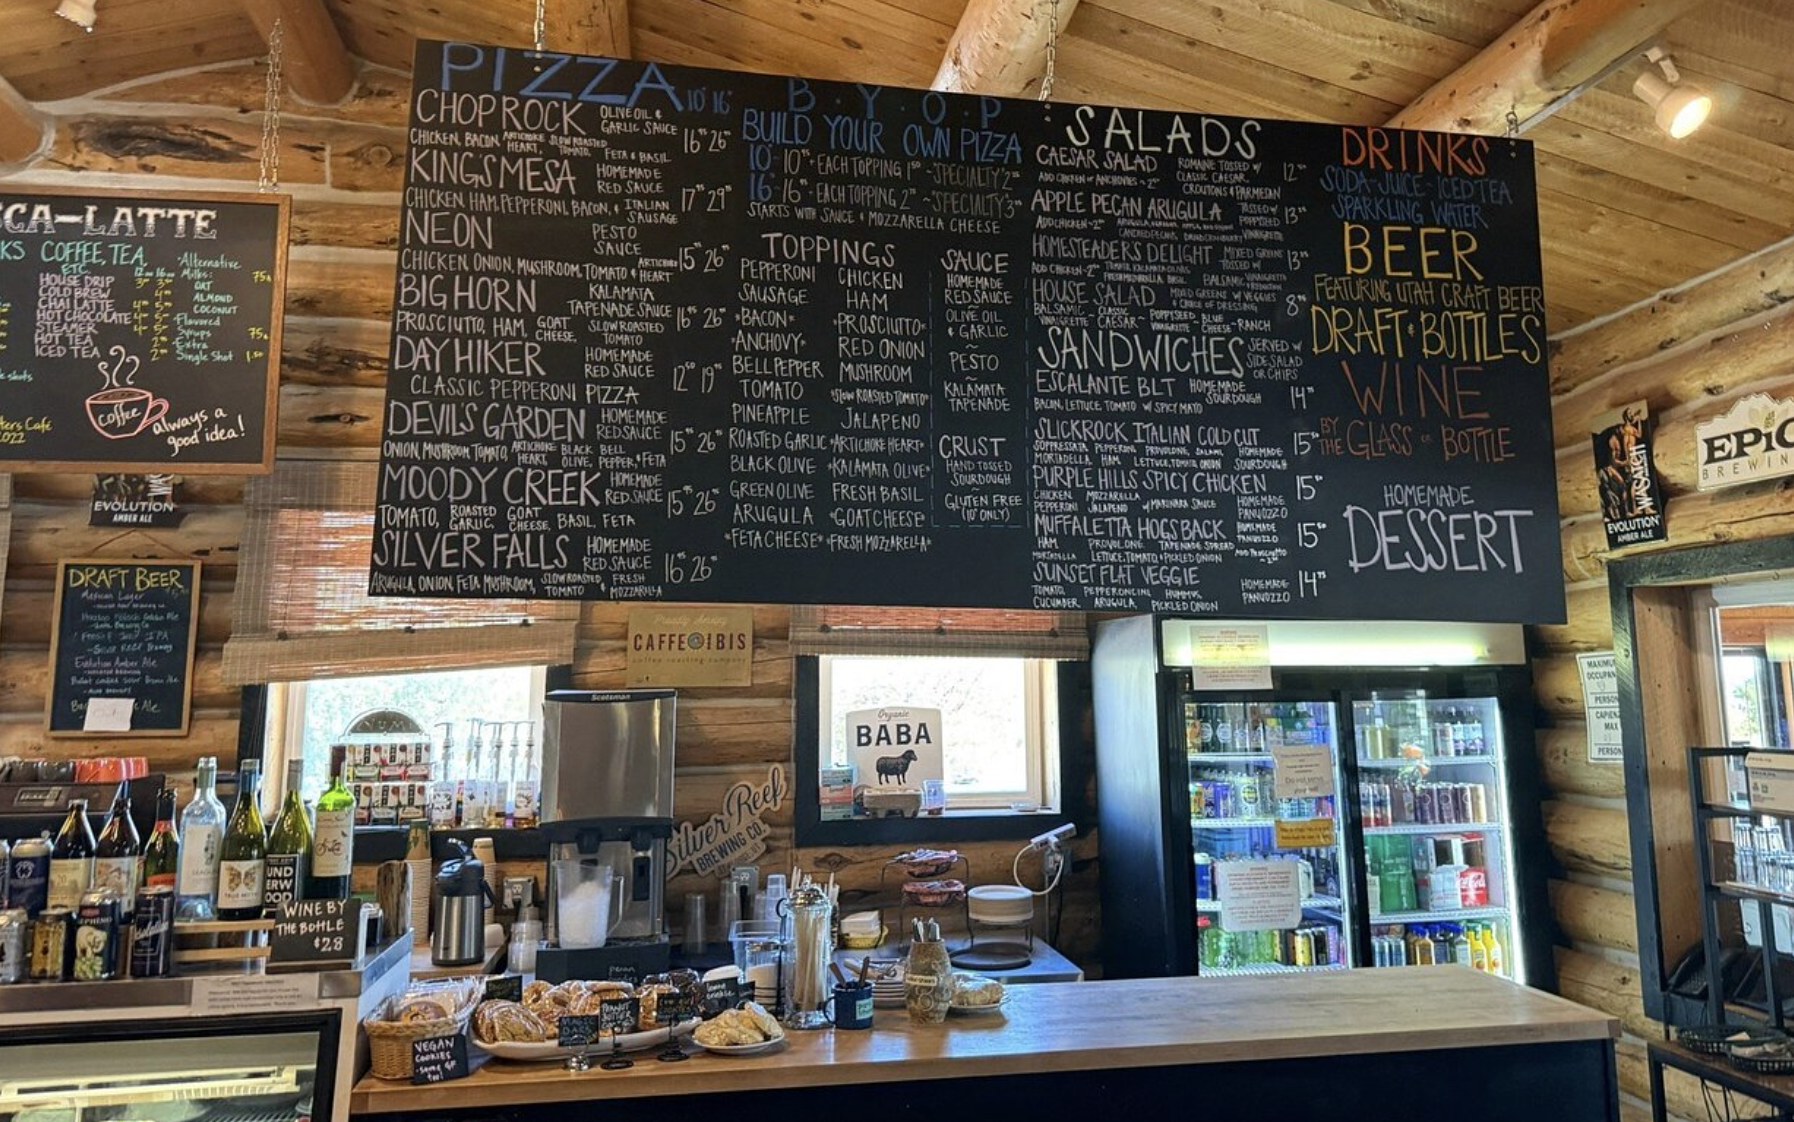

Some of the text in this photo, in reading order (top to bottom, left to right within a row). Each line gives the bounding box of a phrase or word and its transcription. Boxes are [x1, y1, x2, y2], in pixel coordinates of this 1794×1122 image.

[442, 43, 684, 111] PIZZA
[601, 120, 677, 136] GARLIC SAUCE
[742, 108, 1023, 164] BUILD YOUR OWN PIZZA
[1065, 105, 1262, 160] SALADS
[1035, 145, 1158, 173] CAESAR SALAD
[1342, 126, 1489, 176] DRINKS
[499, 156, 576, 195] MESA
[596, 163, 662, 179] HOMEMADE
[817, 154, 901, 179] EACH TOPPING
[1476, 178, 1513, 205] TEA
[624, 200, 669, 212] ITALIAN
[1031, 189, 1223, 222] APPLE PECAN ARUGULA
[1331, 192, 1490, 230] SPARKLING WATER
[406, 210, 493, 249] NEON
[627, 212, 678, 225] SAUSAGE
[592, 224, 637, 240] PESTO
[761, 232, 896, 268] TOPPINGS
[941, 249, 1010, 274] SAUCE
[1149, 243, 1214, 265] DELIGHT
[1343, 221, 1485, 282] BEER
[39, 272, 115, 288] HOUSE DRIP
[740, 259, 816, 282] PEPPERONI
[837, 267, 904, 290] CHICKEN
[38, 285, 110, 300] COLD BREW
[193, 292, 233, 304] ALMOND
[589, 283, 654, 300] KALAMATA
[738, 282, 809, 306] SAUSAGE
[846, 289, 888, 312] HAM
[1032, 279, 1155, 307] HOUSE SALAD
[1314, 273, 1392, 303] FEATURING
[1396, 280, 1435, 305] UTAH
[1440, 282, 1492, 311] CRAFT
[1498, 285, 1546, 313] BEER
[36, 308, 133, 325] HOT CHOCOLATE
[37, 297, 114, 313] CHAI LATTE
[192, 305, 239, 316] COCONUT
[568, 299, 672, 318] TAPENADE SAUCE
[35, 321, 98, 336] STEAMER
[1238, 319, 1271, 332] RANCH
[1310, 304, 1541, 365] DRAFT BOTTLES
[34, 345, 100, 359] ICED TEA
[838, 336, 925, 361] RED ONION
[1038, 325, 1245, 379] SANDWICHES
[584, 363, 655, 378] RED SAUCE
[839, 361, 913, 384] MUSHROOM
[949, 351, 999, 373] PESTO
[410, 374, 639, 405] CLASSIC PEPPERONI PIZZA
[739, 379, 804, 400] TOMATO
[1036, 369, 1176, 398] ESCALANTE BLT
[1340, 360, 1491, 420] WINE
[98, 401, 143, 429] coffee
[151, 407, 228, 436] always a
[482, 405, 586, 443] GARDEN
[601, 409, 667, 424] HOMEMADE
[732, 403, 811, 426] PINEAPPLE
[840, 407, 921, 430] JALAPENO
[167, 414, 246, 457] good idea!
[1034, 416, 1260, 447] SLICKROCK ITALIAN COLD CUT
[1318, 416, 1516, 463] BY THE GLASS BOTTLE
[938, 434, 1007, 459] CRUST
[382, 465, 601, 507] MOODY CREEK
[1033, 465, 1267, 495] PURPLE HILLS SPICY CHICKEN
[94, 501, 175, 513] EVOLUTION
[944, 493, 1023, 509] GLUTEN FREE
[1383, 484, 1475, 508] HOMEMADE
[112, 512, 153, 524] AMBER ALE
[732, 503, 815, 525] ARUGULA
[1034, 514, 1132, 537] MUFFALETTA
[1607, 515, 1660, 535] EVOLUTION
[1342, 503, 1535, 576] DESSERT
[1617, 530, 1654, 543] AMBER ALE
[373, 531, 570, 570] SILVER FALLS
[69, 567, 184, 591] DRAFT BEER
[1033, 562, 1200, 587] SUNSET FLAT VEGGIE
[633, 632, 686, 652] CAFFE
[856, 722, 932, 748] BABA
[727, 766, 781, 826] Reef
[696, 821, 767, 873] BREWING CO.
[266, 865, 294, 878] UND
[283, 899, 347, 919] WINE BY
[275, 922, 297, 937] THE
[313, 937, 344, 952] $28
[414, 1037, 455, 1053] VEGAN
[415, 1050, 452, 1063] COOKIES
